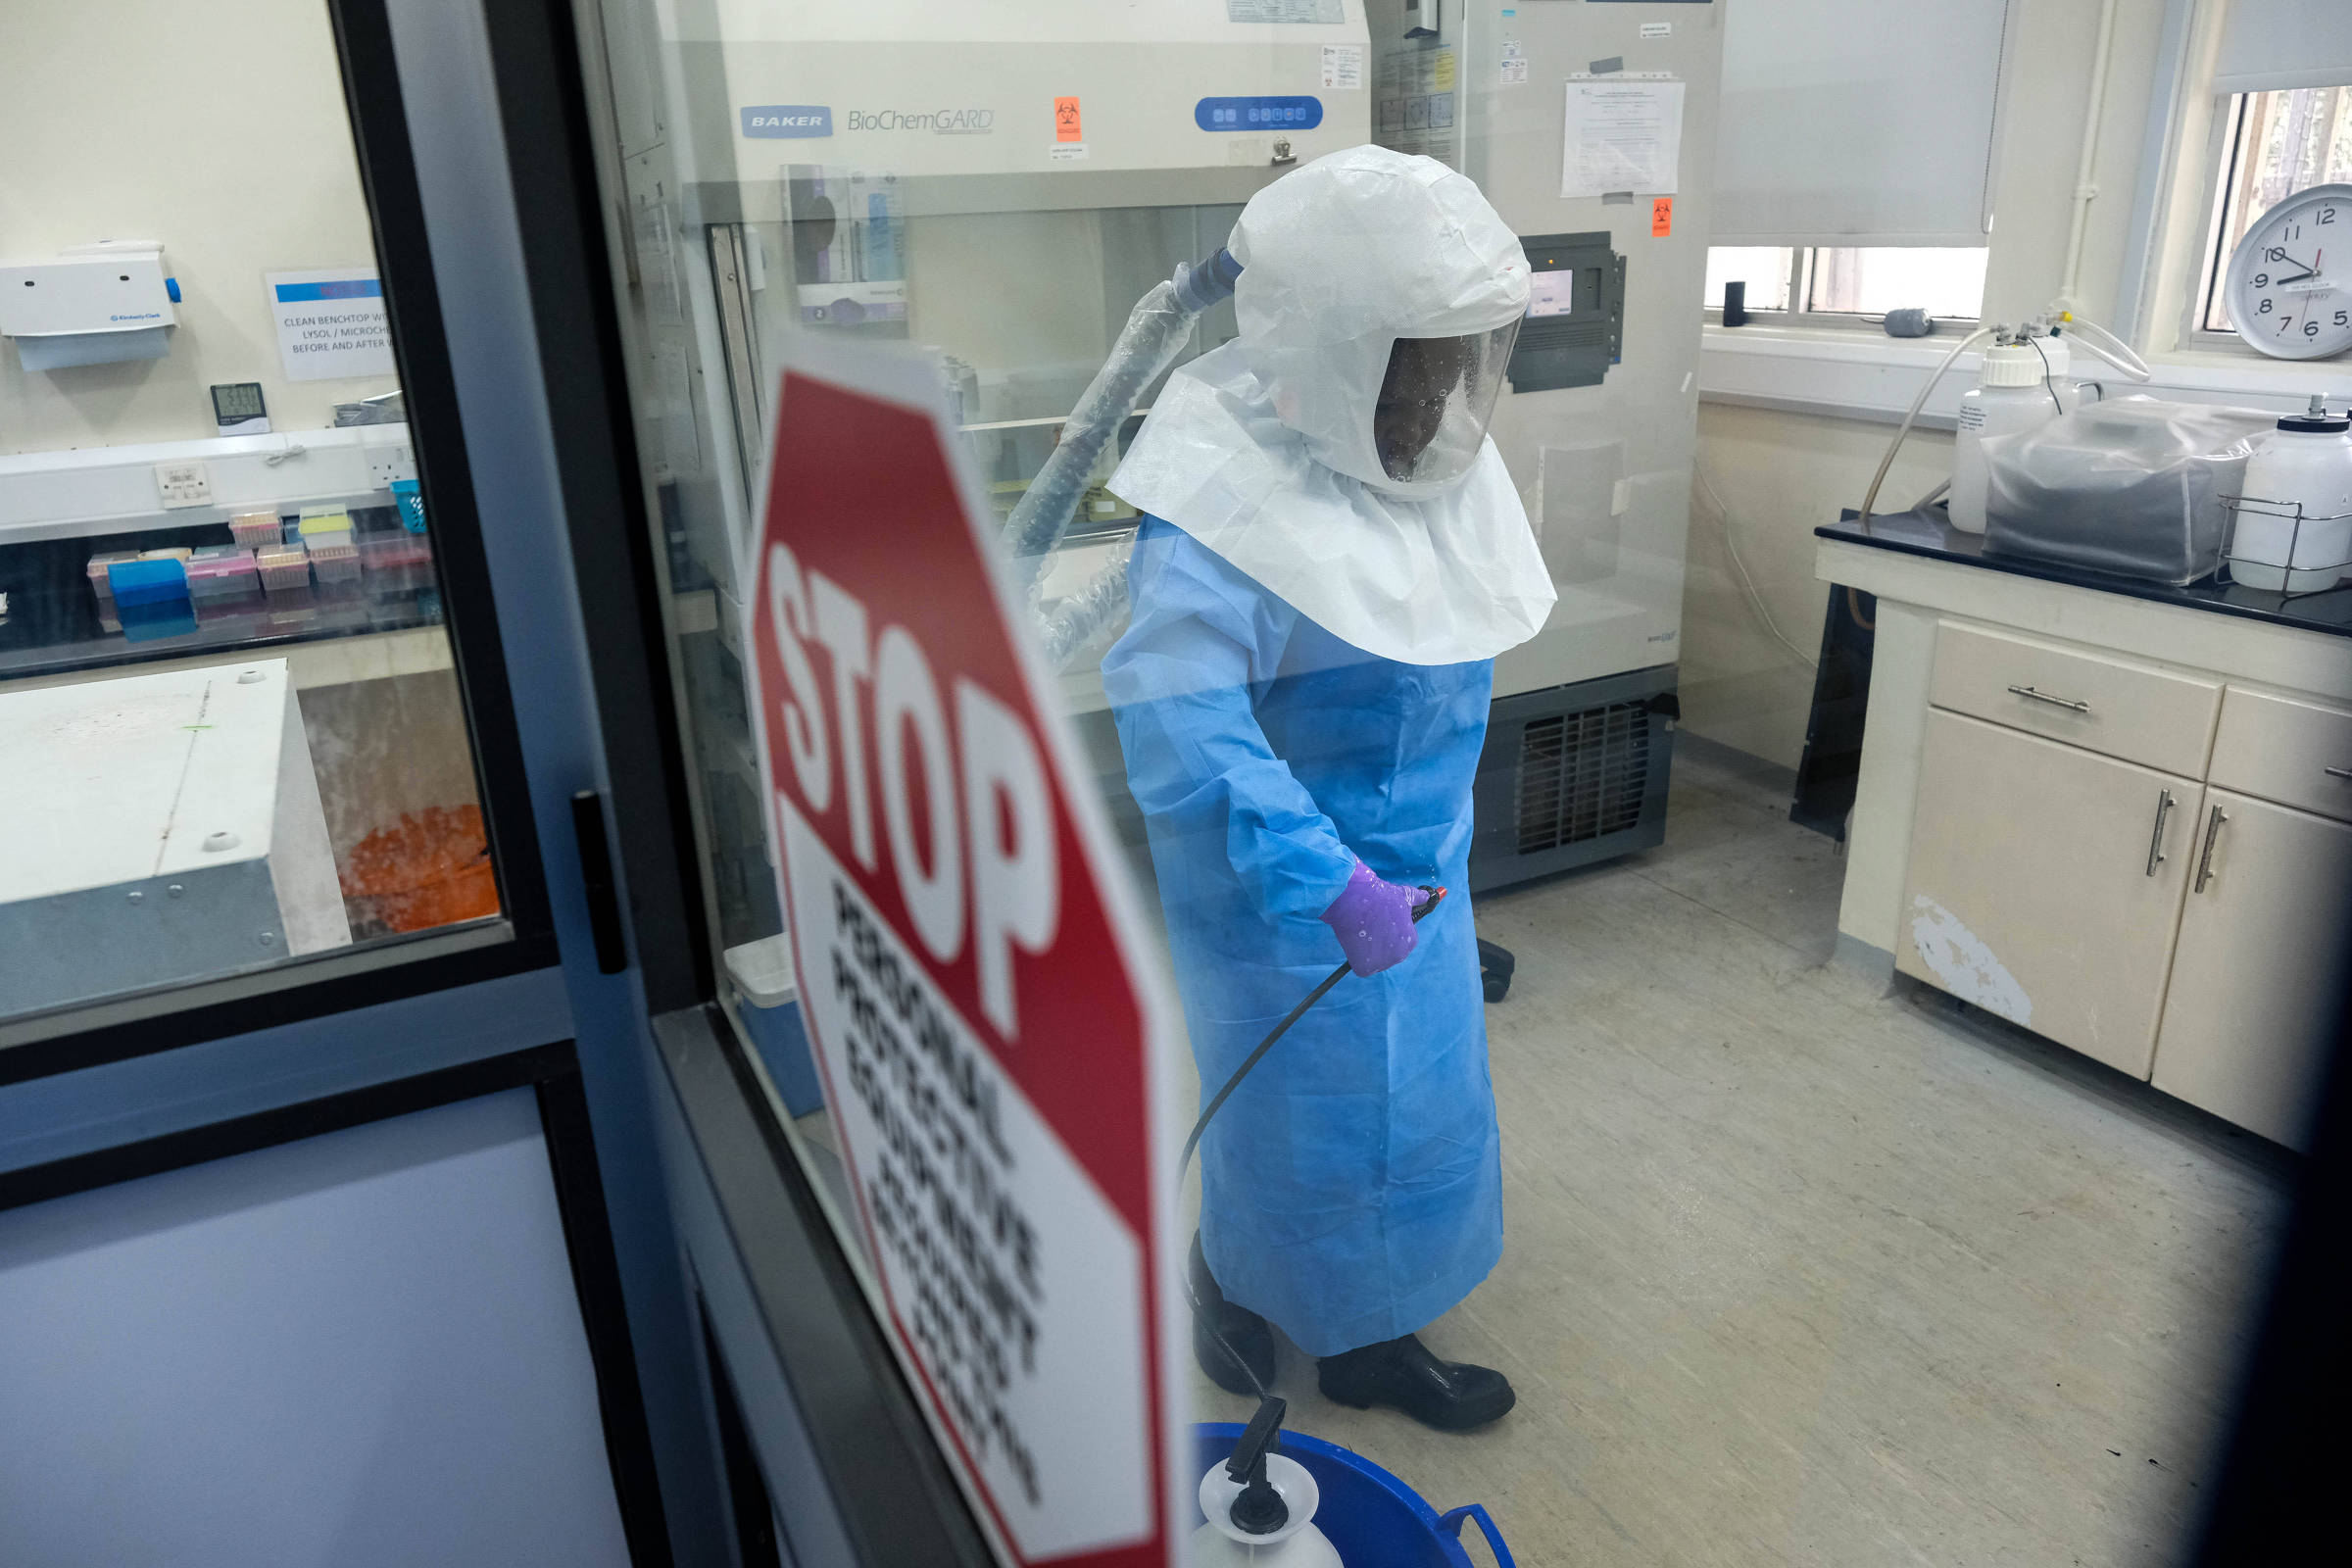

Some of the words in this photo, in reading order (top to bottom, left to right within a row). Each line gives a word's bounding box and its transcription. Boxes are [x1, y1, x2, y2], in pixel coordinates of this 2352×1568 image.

[751, 116, 823, 127] BAKER
[847, 109, 993, 130] BioChemGARD
[2316, 208, 2336, 225] 12
[2283, 225, 2300, 241] 11
[2265, 247, 2285, 263] 10
[2255, 273, 2269, 288] 9
[2259, 299, 2273, 314] 8
[284, 318, 316, 327] CLEAN
[318, 314, 370, 324] BENCHTOP
[2279, 317, 2292, 331] 7
[2333, 311, 2348, 325] 5
[302, 329, 331, 339] LYSOL
[2304, 321, 2319, 336] 6
[292, 343, 329, 354] BEFORE
[331, 341, 353, 351] AND
[356, 339, 385, 349] AFTER
[769, 541, 1060, 1045] STOP
[832, 877, 1016, 1174] PERSONAL
[831, 943, 1045, 1310] PROTECTIVE
[844, 1026, 1038, 1380] EQUIPMENT
